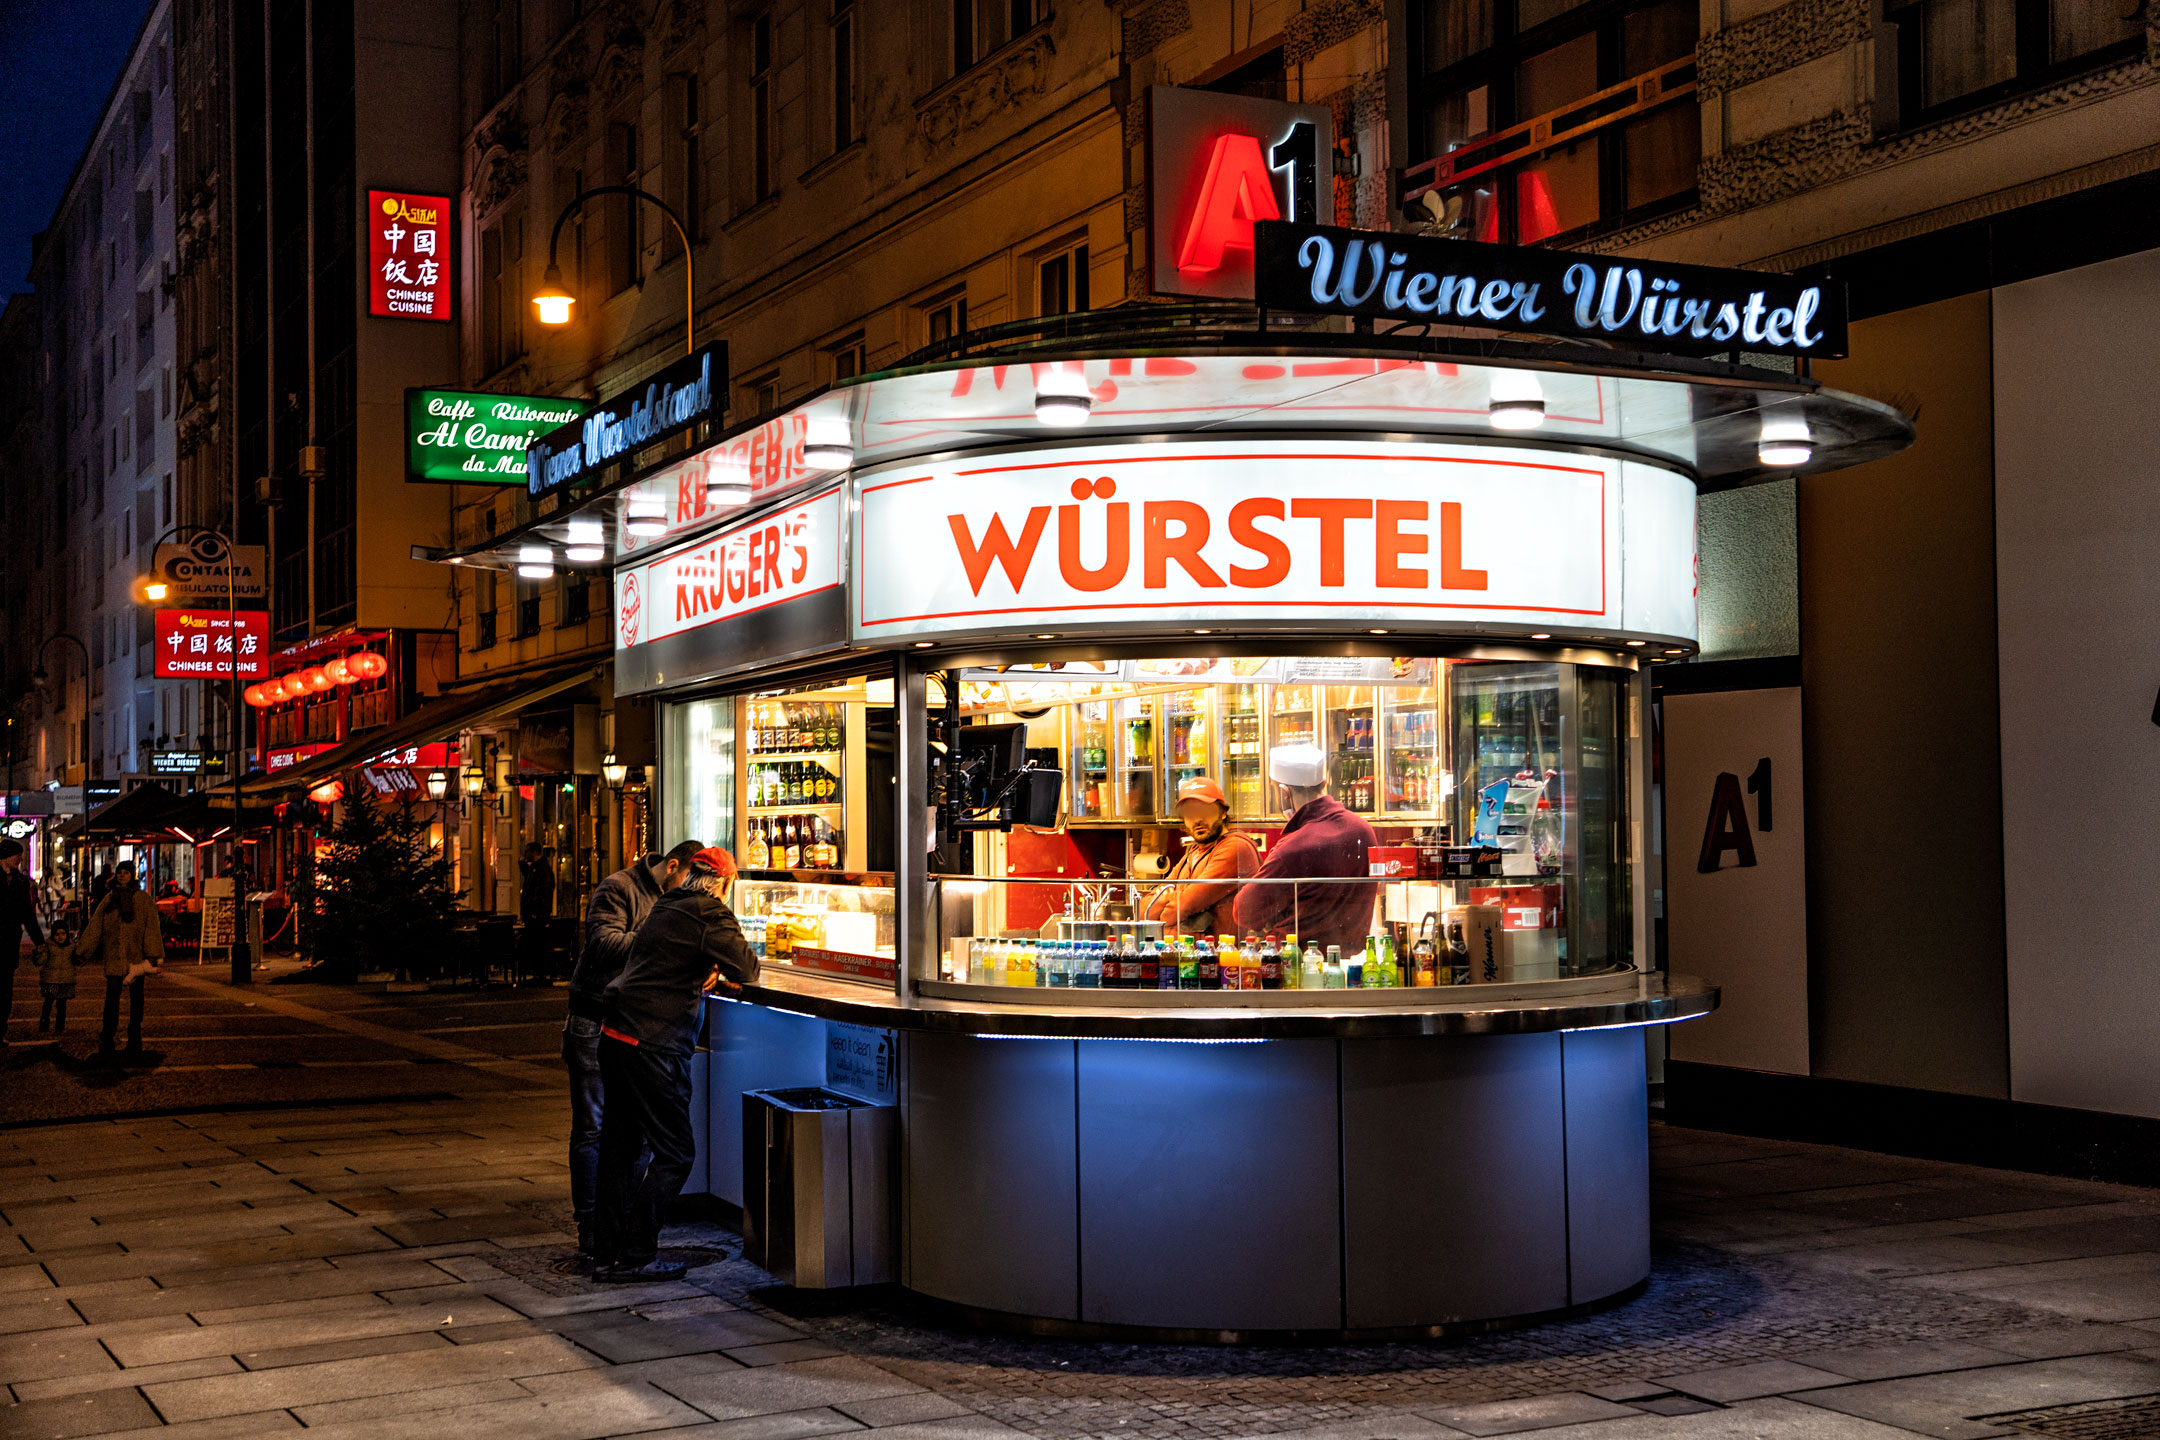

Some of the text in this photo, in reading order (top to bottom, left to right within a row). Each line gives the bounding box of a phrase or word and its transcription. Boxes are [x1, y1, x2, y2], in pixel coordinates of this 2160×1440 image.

[1177, 121, 1317, 272] A1
[384, 223, 436, 257] 中国
[381, 258, 439, 287] 饭店
[387, 289, 434, 302] CHINESE
[1299, 235, 1824, 347] Wiener Würstel
[388, 301, 432, 314] CUISINE
[428, 398, 475, 420] Caffe
[527, 443, 582, 494] Wiener
[583, 352, 711, 466] Würstelstand
[417, 422, 541, 451] Al Cami
[462, 455, 486, 473] da
[946, 476, 1488, 598] WÜRSTEL
[168, 661, 257, 672] CHINESE CUSINE
[1697, 757, 1773, 875] A1
